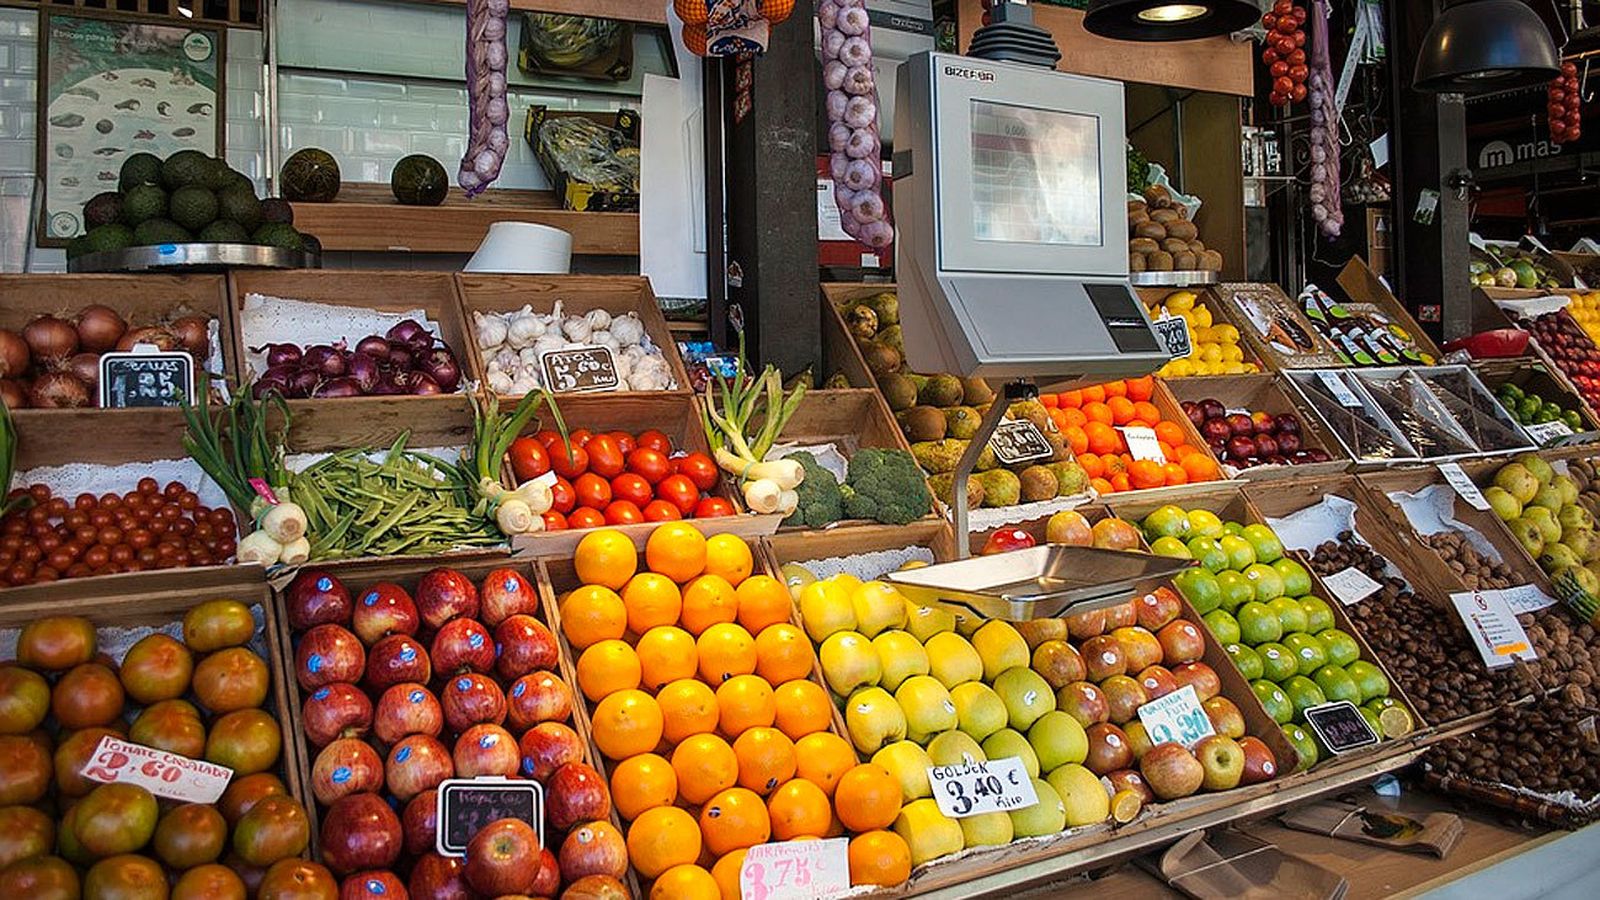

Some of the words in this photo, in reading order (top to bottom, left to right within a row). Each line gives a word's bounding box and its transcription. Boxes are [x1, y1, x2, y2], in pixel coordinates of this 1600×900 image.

[87, 752, 182, 782] 2,60
[946, 775, 1003, 815] 3,40
[744, 857, 812, 900] 3,75
